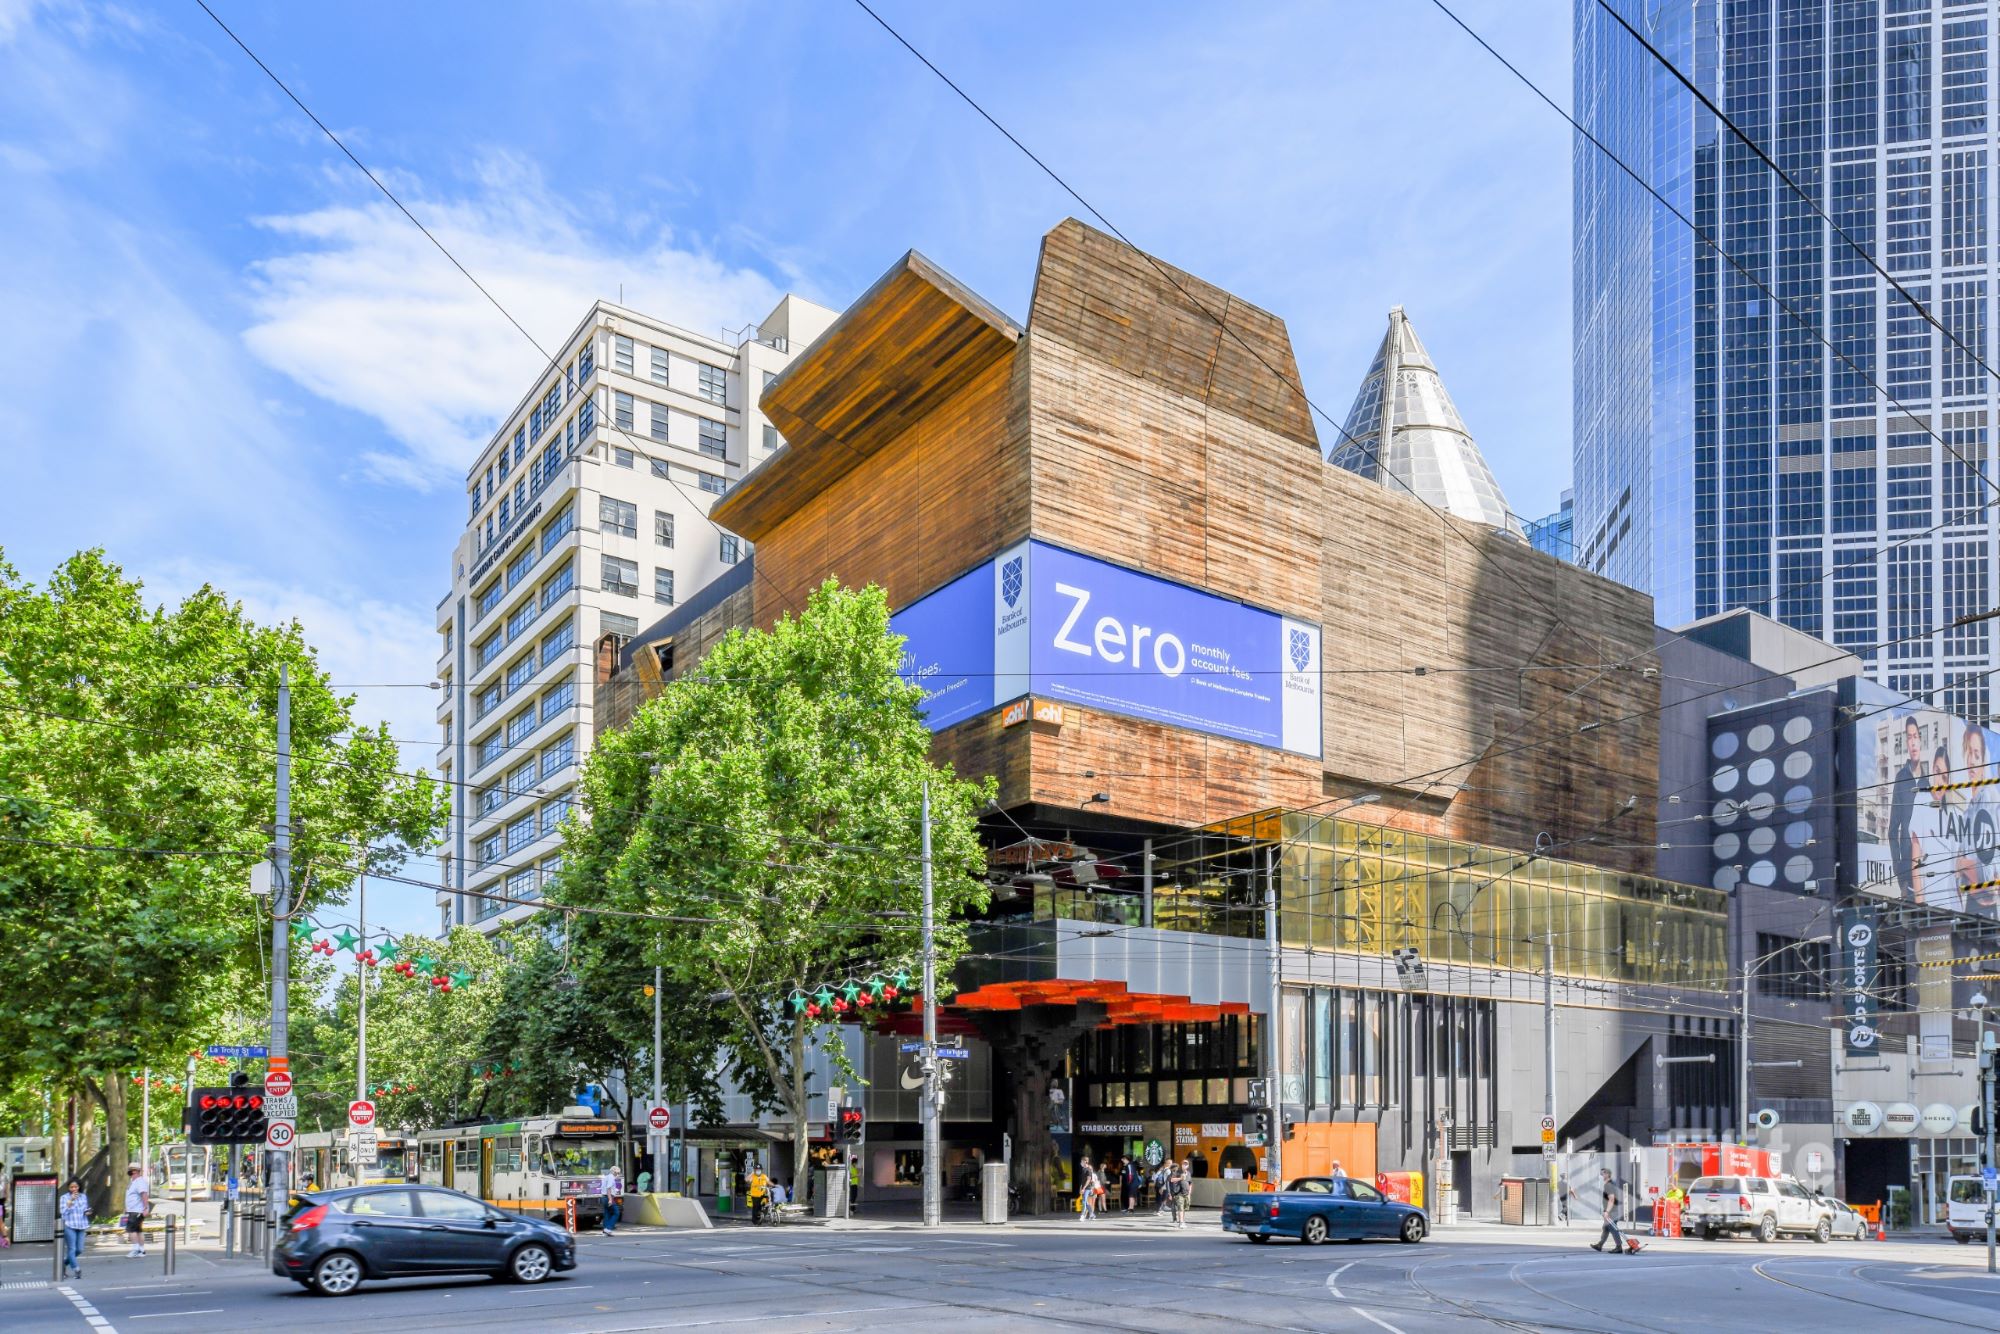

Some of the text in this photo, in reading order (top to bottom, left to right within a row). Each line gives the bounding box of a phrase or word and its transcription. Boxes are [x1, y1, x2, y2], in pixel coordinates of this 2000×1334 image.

[1001, 606, 1023, 625] Bank of
[997, 616, 1028, 636] Melbourne
[1053, 582, 1186, 678] Zero
[1191, 643, 1231, 664] monthly
[917, 661, 942, 682] fees.
[1191, 657, 1254, 681] account fees.
[1289, 672, 1311, 685] Bank of
[1284, 680, 1316, 695] Melbourne
[1866, 859, 1887, 886] LEVEL
[209, 1046, 219, 1054] La
[220, 1046, 240, 1055] Trobe
[1081, 1124, 1143, 1132] STARBUCKS COFFEE
[1175, 1127, 1194, 1136] SEOUL
[1544, 1120, 1552, 1128] 30
[271, 1129, 290, 1140] 30
[1175, 1136, 1198, 1144] STATION
